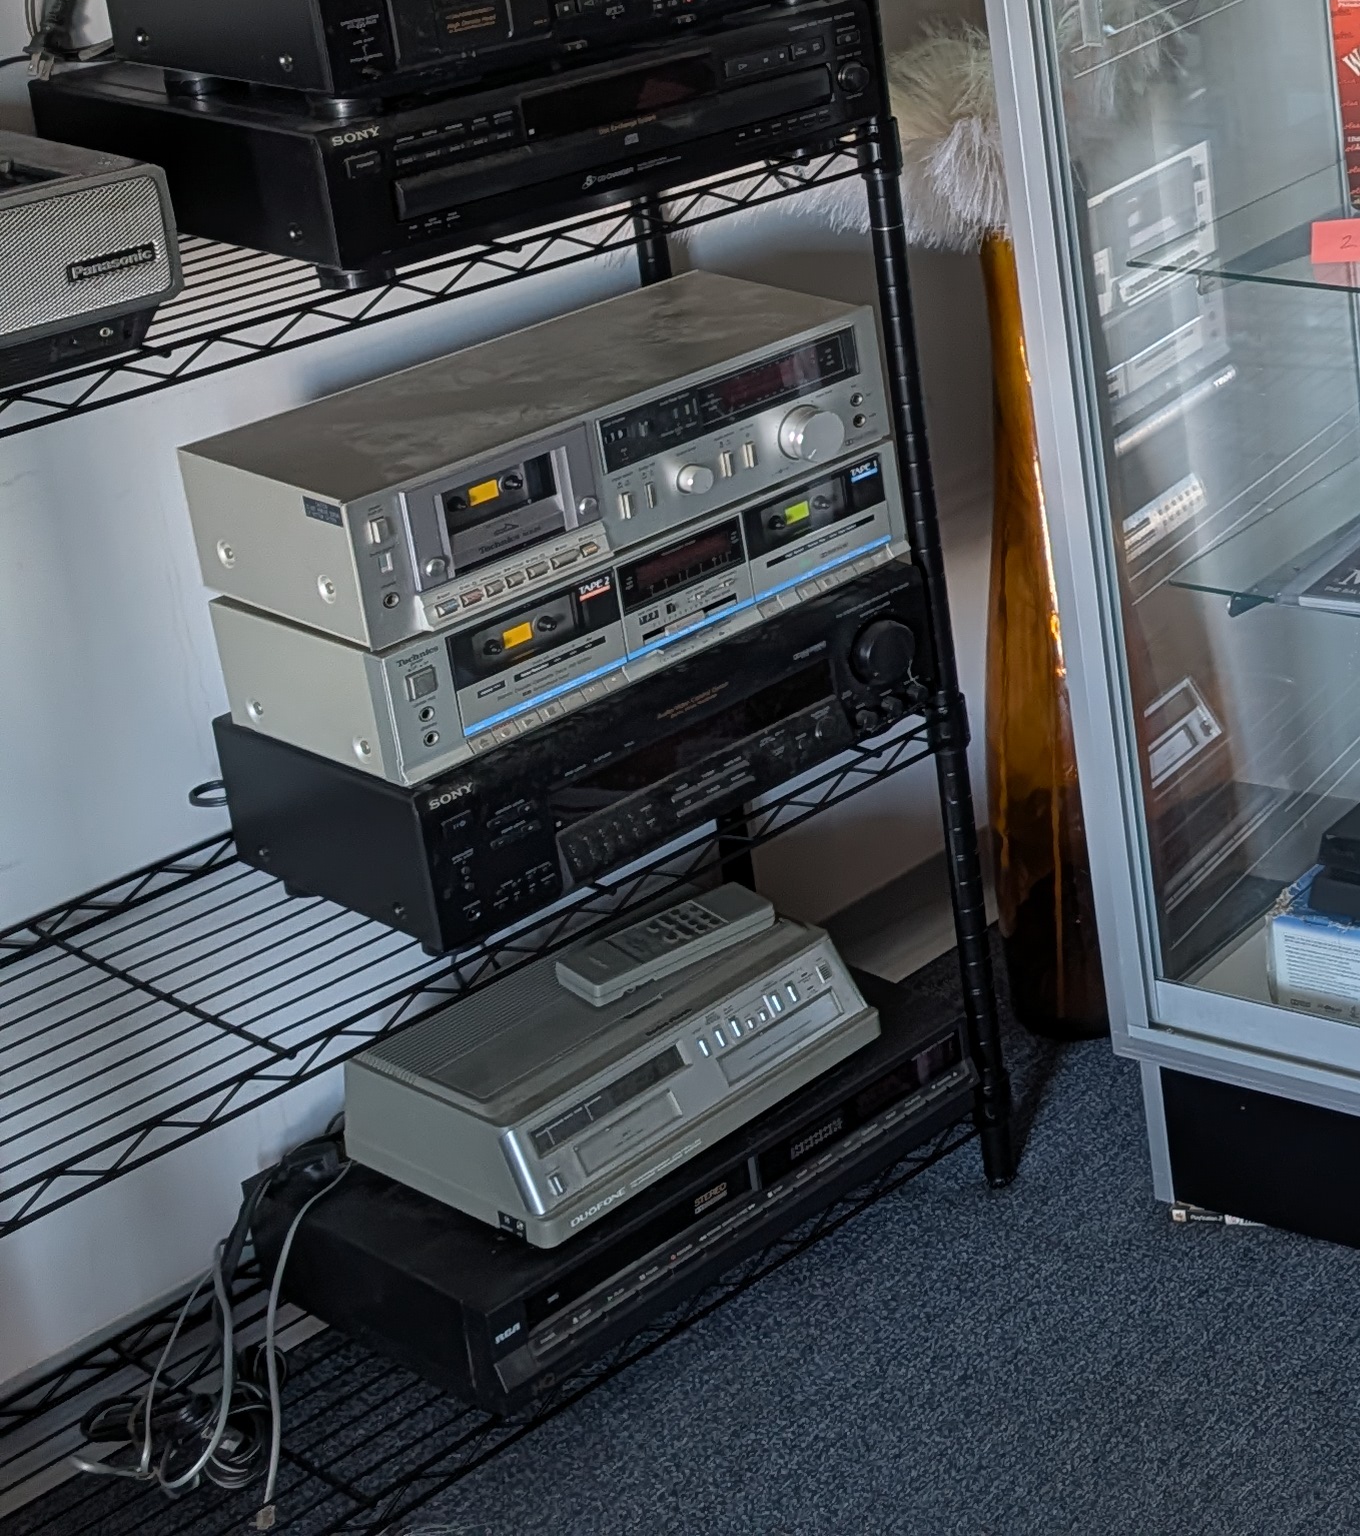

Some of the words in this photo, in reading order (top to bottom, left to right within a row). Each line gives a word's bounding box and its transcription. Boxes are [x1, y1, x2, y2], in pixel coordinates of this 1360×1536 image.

[331, 125, 381, 147] SONY
[71, 248, 153, 280] Panasonic
[850, 462, 872, 477] TAPE
[478, 532, 521, 555] Technics
[578, 579, 603, 594] TAPE
[604, 575, 611, 586] 2
[395, 645, 439, 667] Technics
[428, 781, 474, 811] SONY
[693, 1181, 728, 1207] STEREO
[569, 1185, 627, 1228] DUOFONE
[494, 1321, 521, 1345] RCA
